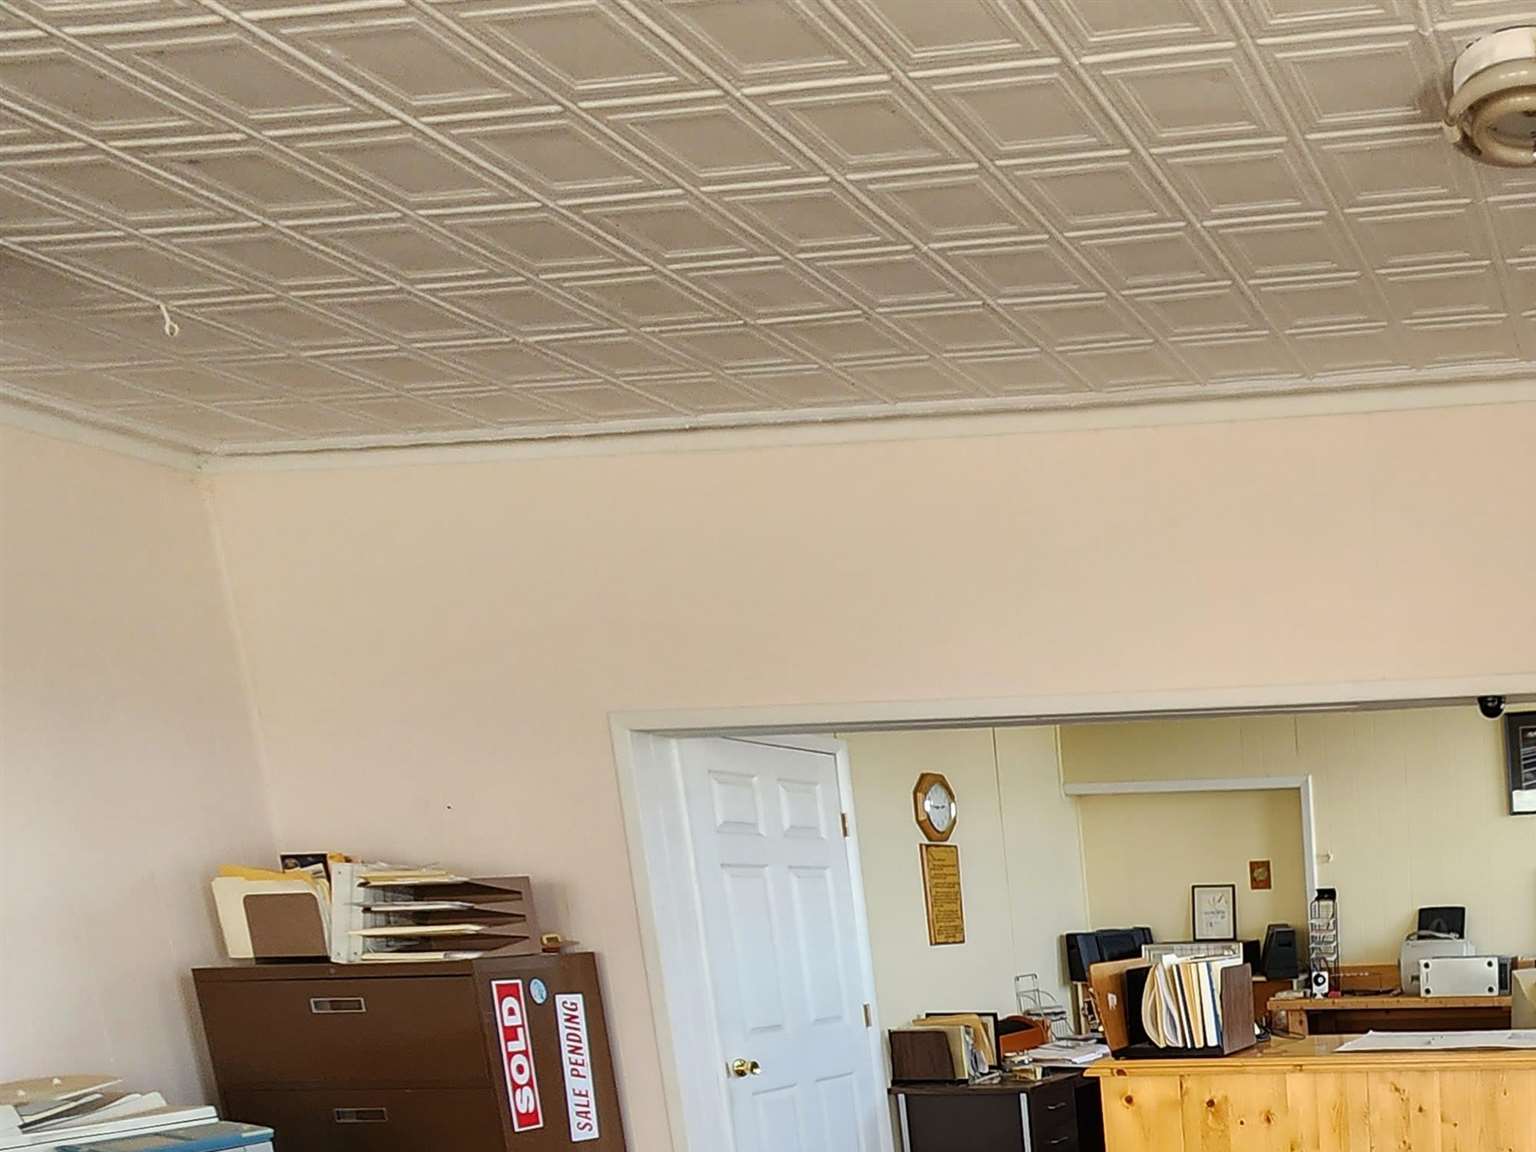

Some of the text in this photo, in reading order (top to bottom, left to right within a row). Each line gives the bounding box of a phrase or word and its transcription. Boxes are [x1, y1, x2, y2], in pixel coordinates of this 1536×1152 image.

[501, 996, 535, 1114] SOLD
[561, 1000, 593, 1133] SALE PENDING
